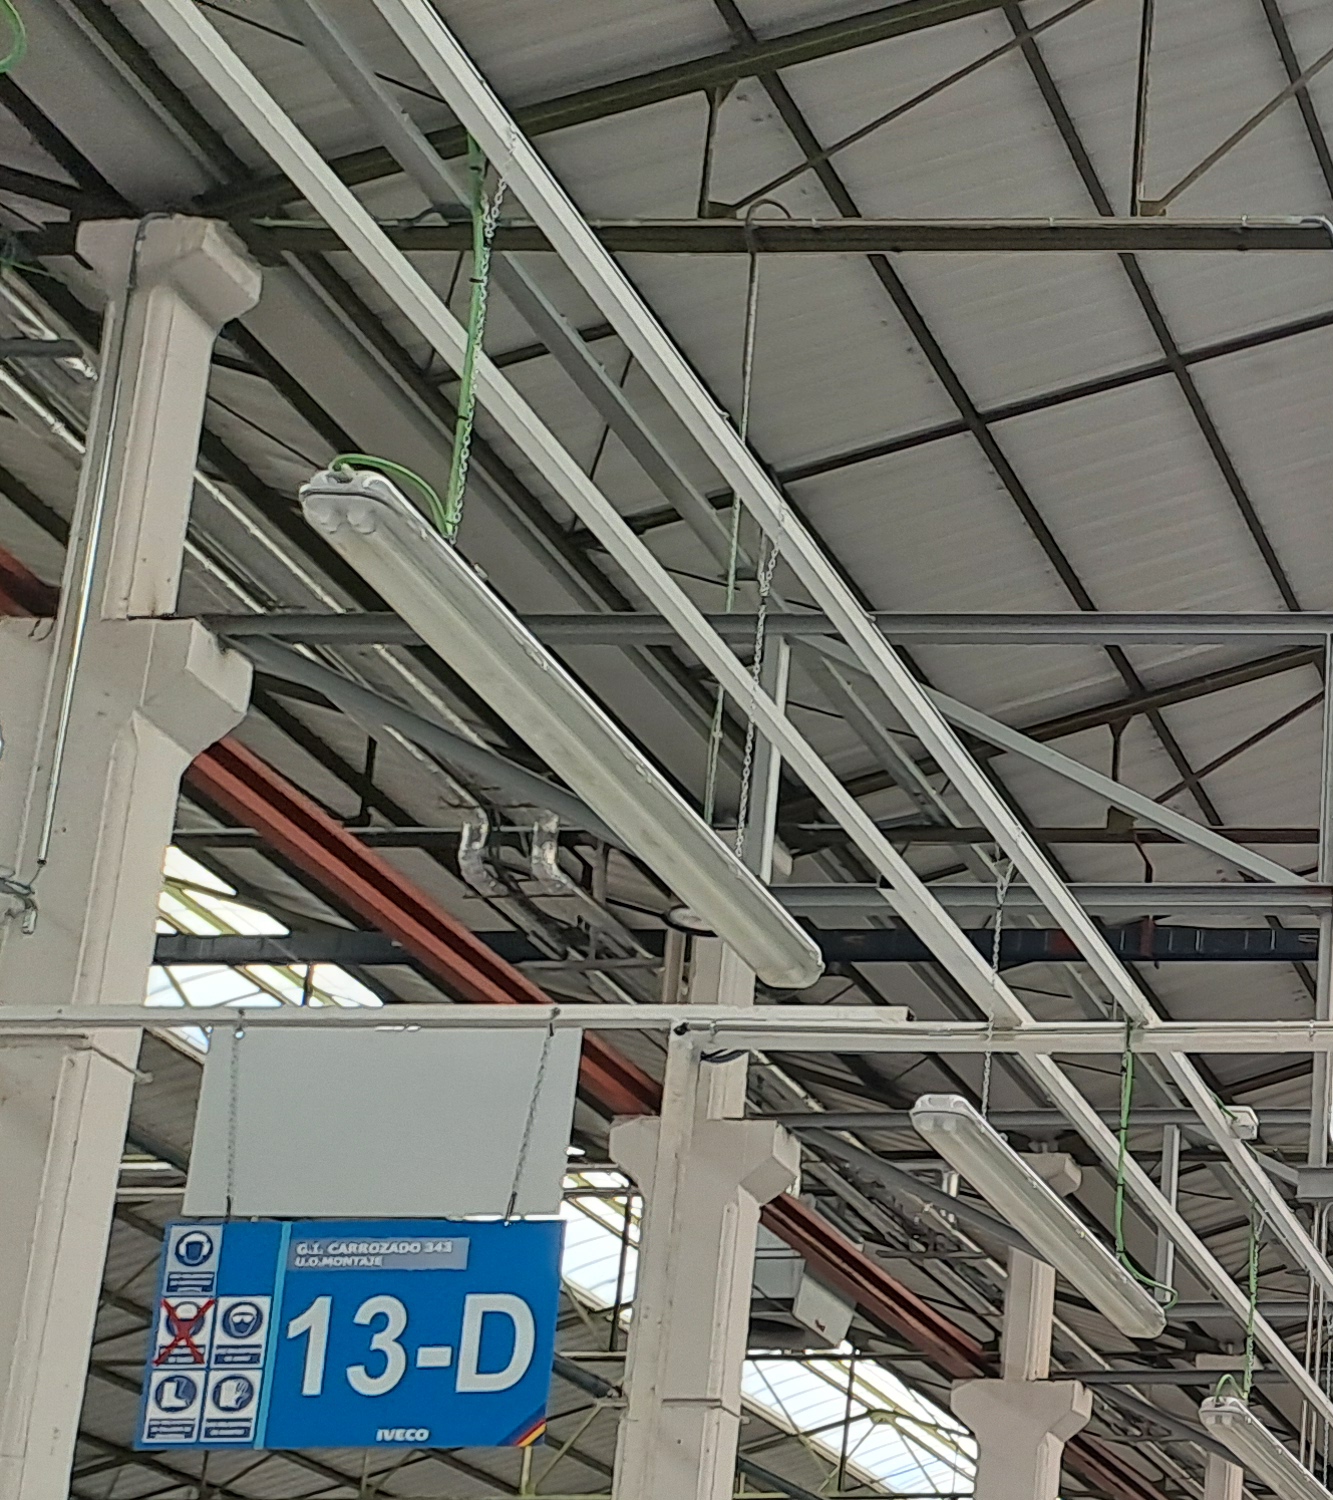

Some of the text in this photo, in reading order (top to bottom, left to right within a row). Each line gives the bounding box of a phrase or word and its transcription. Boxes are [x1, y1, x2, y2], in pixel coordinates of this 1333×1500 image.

[327, 1241, 421, 1255] CARROZADO
[286, 1293, 536, 1396] 13-D
[375, 1428, 430, 1442] IVECO
